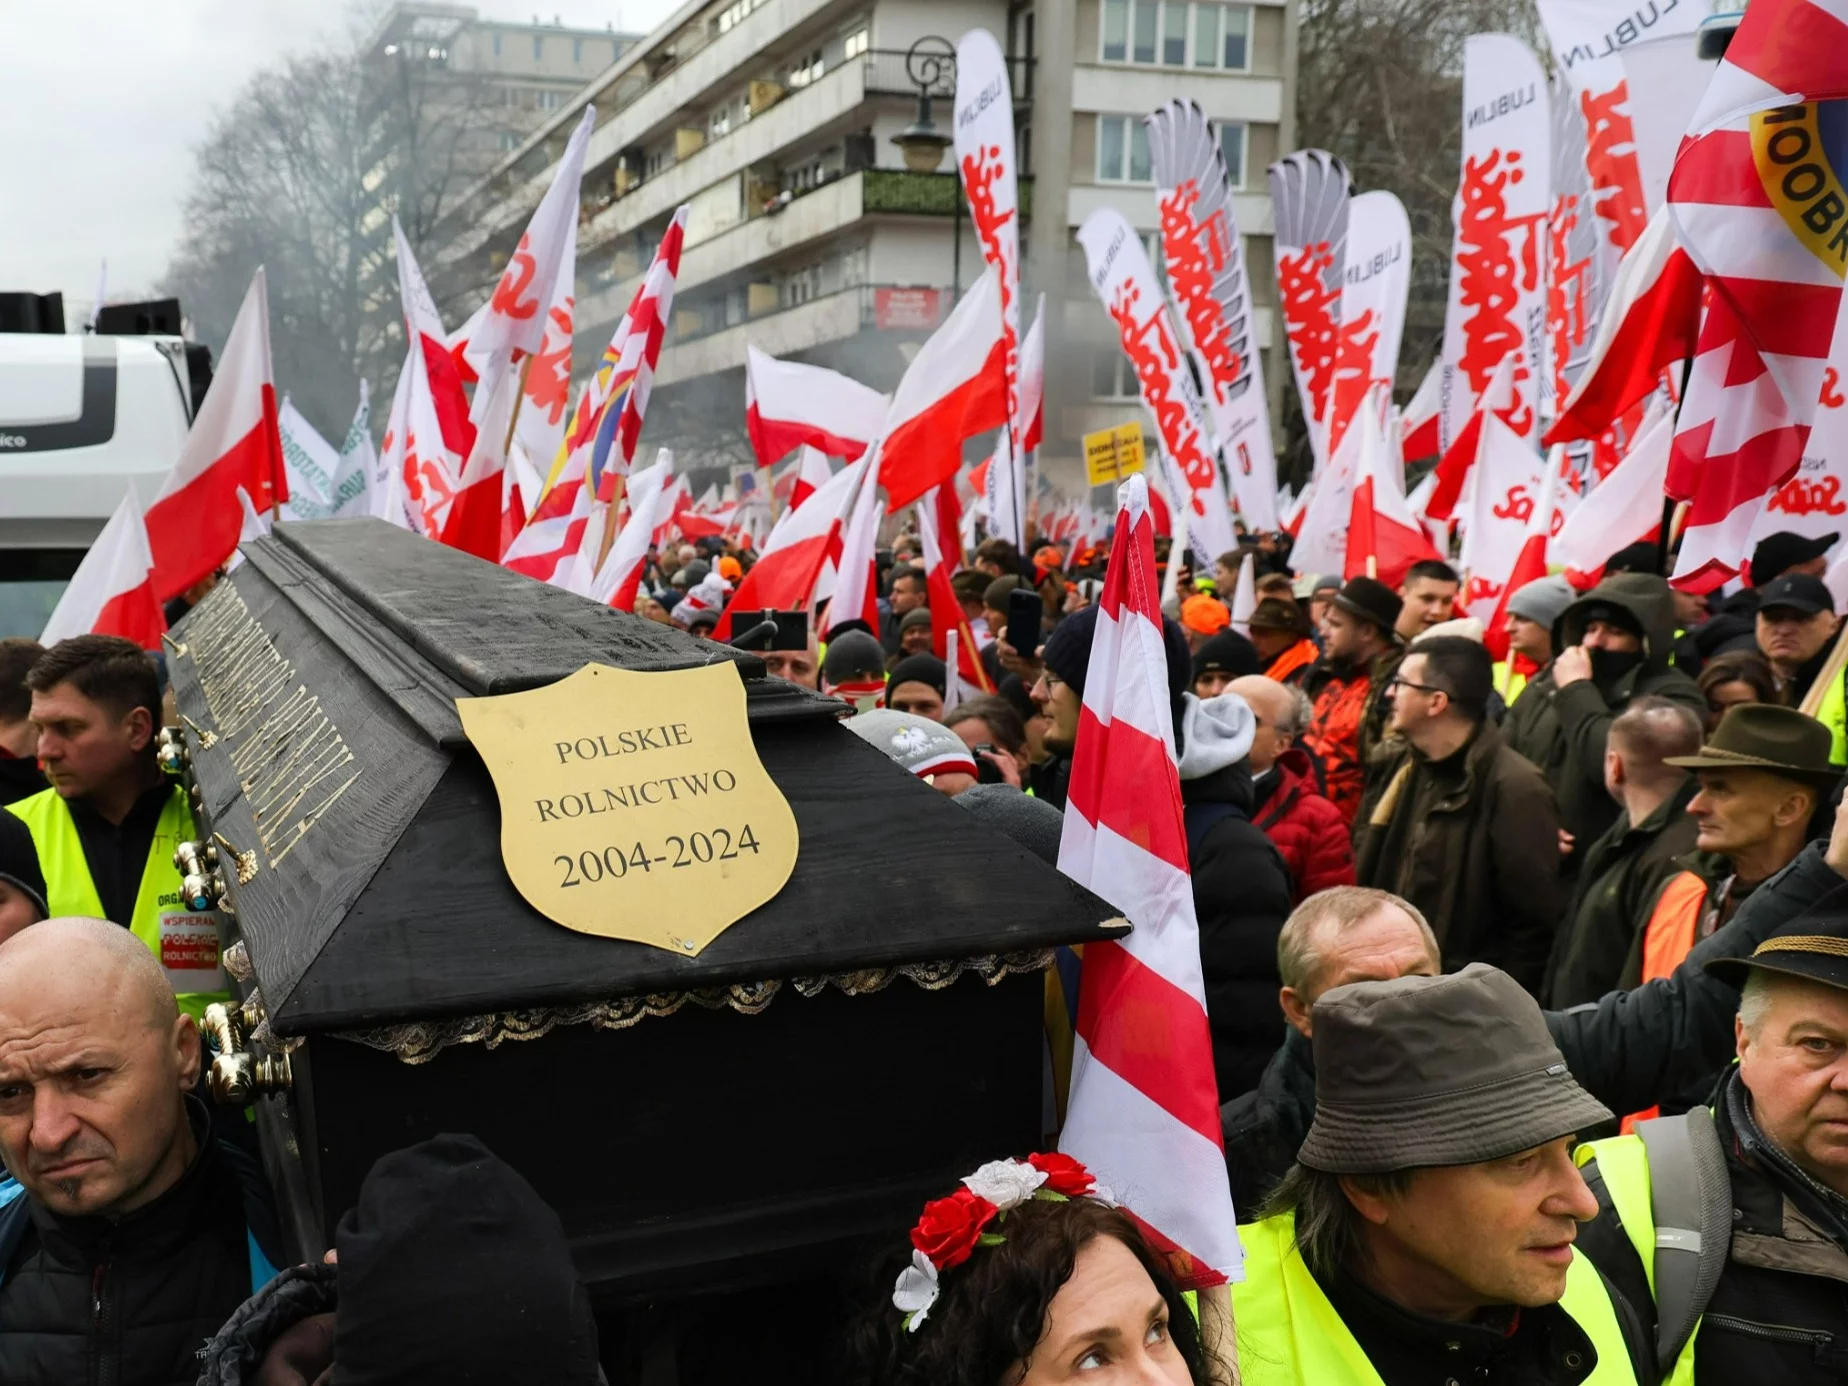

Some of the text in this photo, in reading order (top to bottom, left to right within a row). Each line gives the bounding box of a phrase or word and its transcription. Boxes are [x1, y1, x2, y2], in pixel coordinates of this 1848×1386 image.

[0, 433, 27, 448] ico
[554, 722, 694, 765] POLSKIE
[230, 684, 365, 870] ROLNIKA
[534, 768, 737, 823] ROLNICTWO
[553, 823, 761, 889] 2004-2024
[163, 932, 218, 945] POLSKIE
[163, 950, 217, 963] ROLNICTWO
